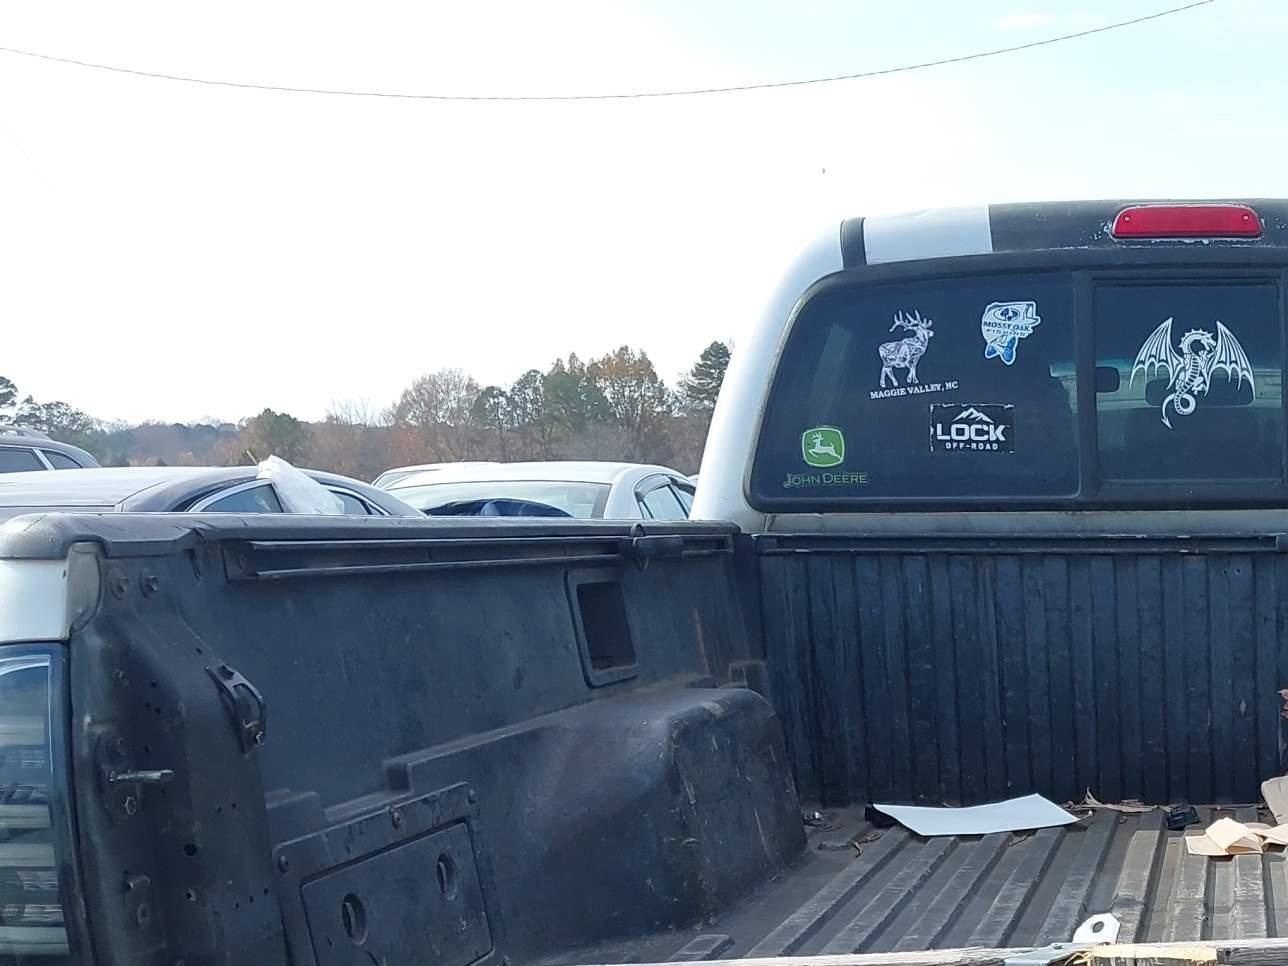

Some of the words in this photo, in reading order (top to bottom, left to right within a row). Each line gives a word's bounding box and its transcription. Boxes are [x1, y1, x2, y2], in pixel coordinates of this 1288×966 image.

[983, 321, 1013, 330] MOSSY
[1012, 324, 1031, 332] OAK
[870, 388, 907, 399] MAGGIE
[907, 383, 945, 394] VALLEY,
[945, 381, 959, 390] NC
[936, 423, 1007, 441] LOCK
[945, 442, 999, 450] OFF-ROAD
[783, 473, 820, 488] JOHN
[822, 472, 867, 484] DEERE
